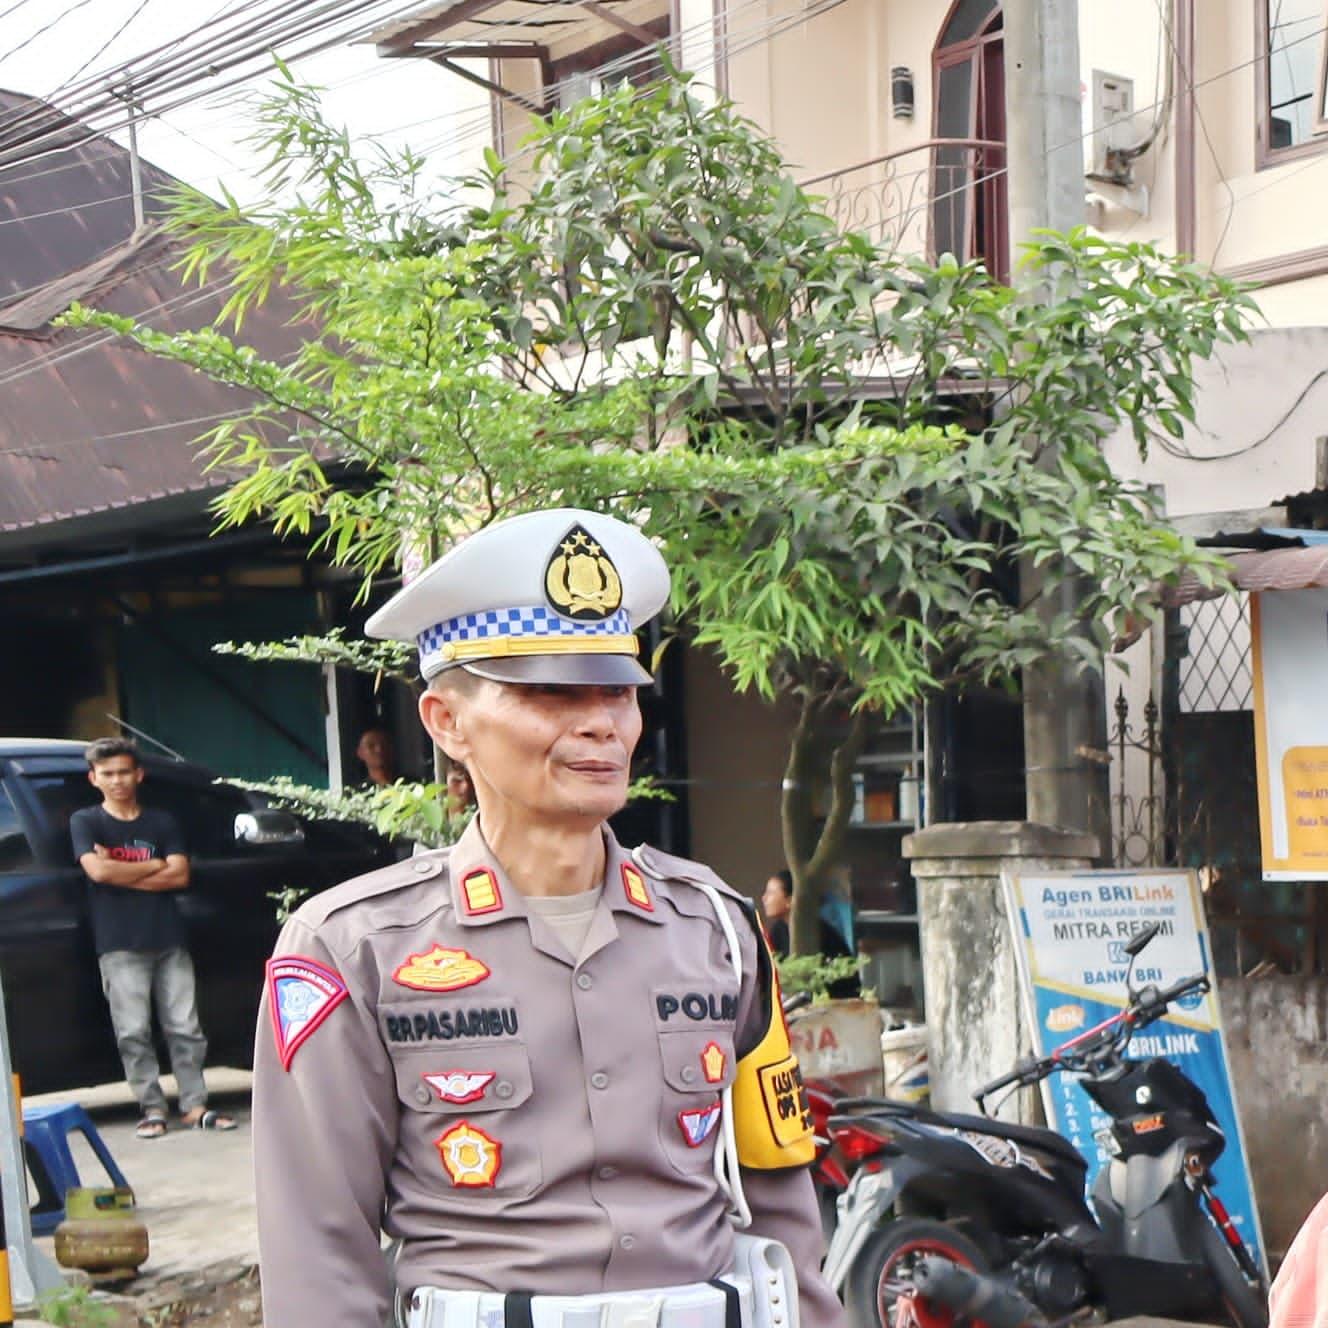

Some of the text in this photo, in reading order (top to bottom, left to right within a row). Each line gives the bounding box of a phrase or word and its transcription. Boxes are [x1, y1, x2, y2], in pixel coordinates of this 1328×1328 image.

[1042, 884, 1174, 907] Agen BRILink
[1053, 922, 1113, 941] MITRA
[1135, 968, 1163, 981] BRI
